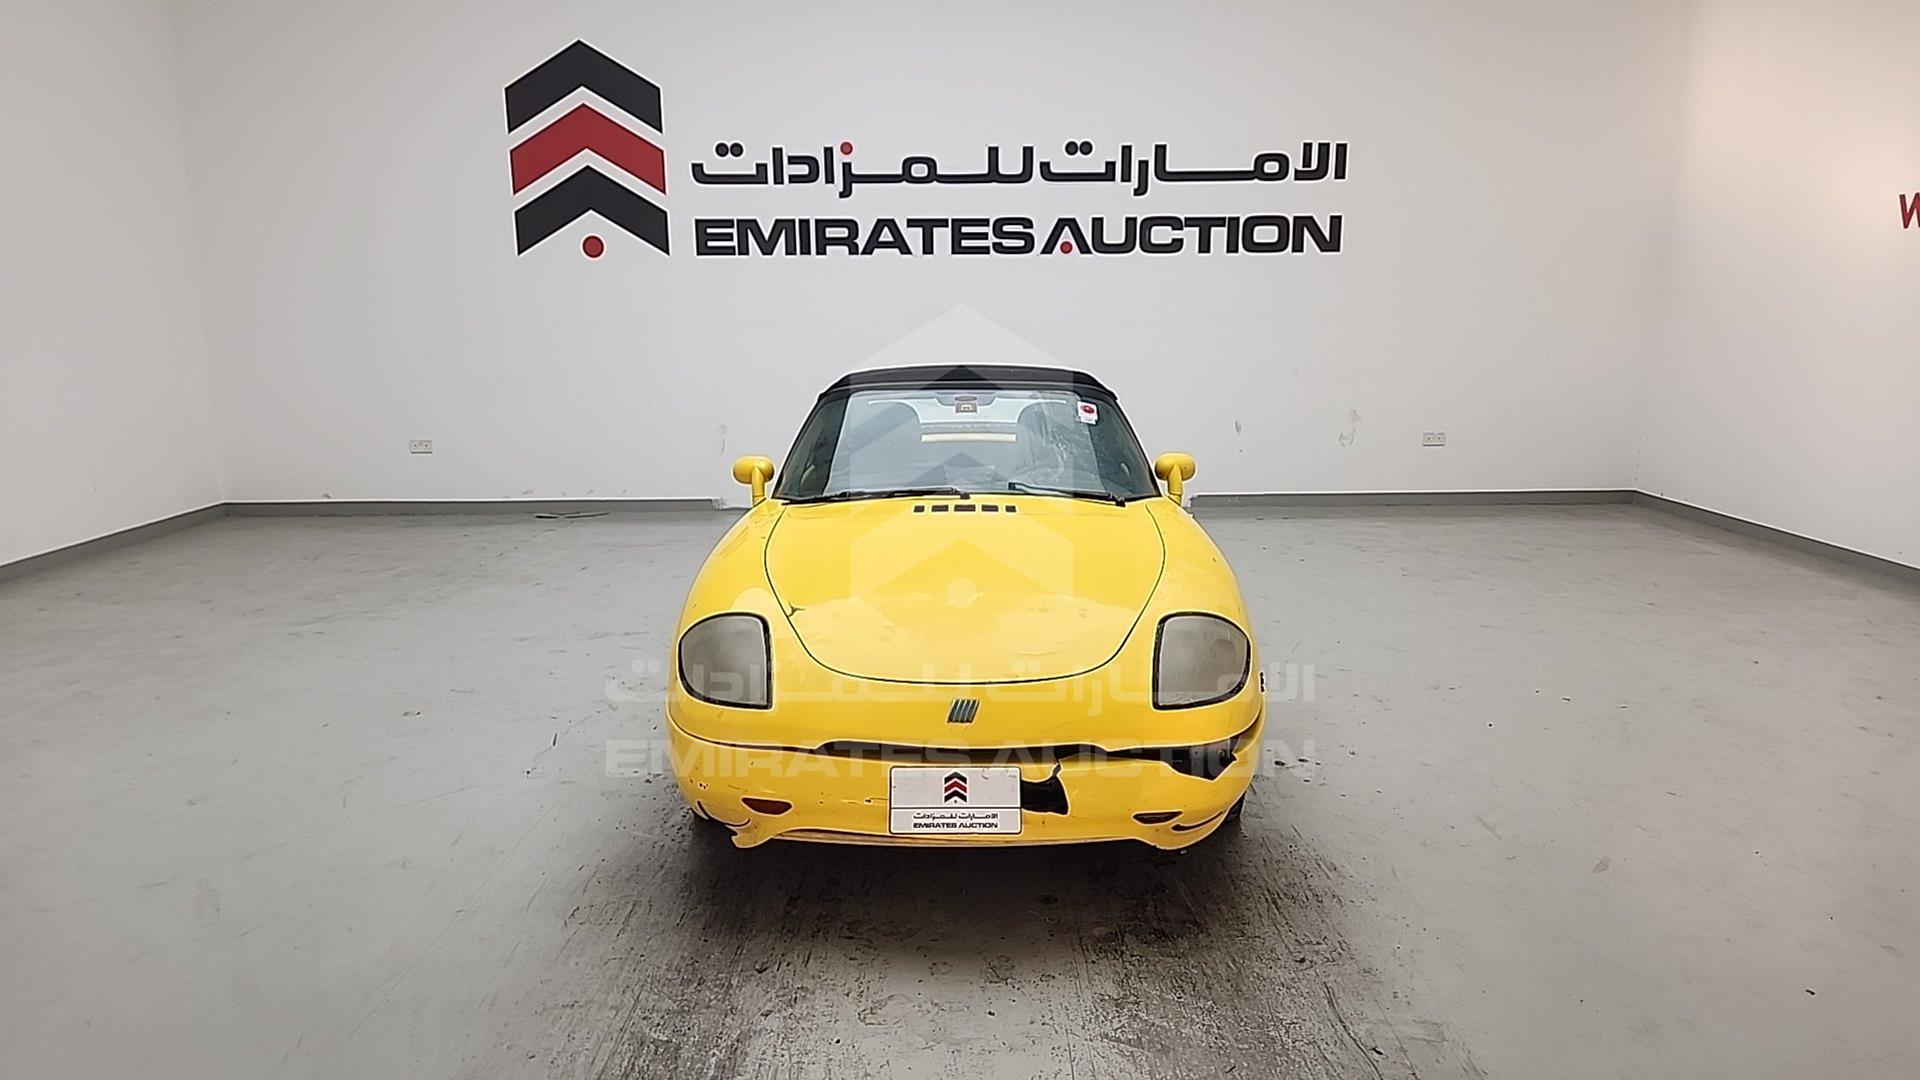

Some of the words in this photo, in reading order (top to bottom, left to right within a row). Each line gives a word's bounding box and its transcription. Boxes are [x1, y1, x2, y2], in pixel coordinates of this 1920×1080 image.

[692, 142, 1034, 198] للمزادات
[695, 217, 1035, 256] EMIRATES
[1040, 215, 1343, 255] AUCTION
